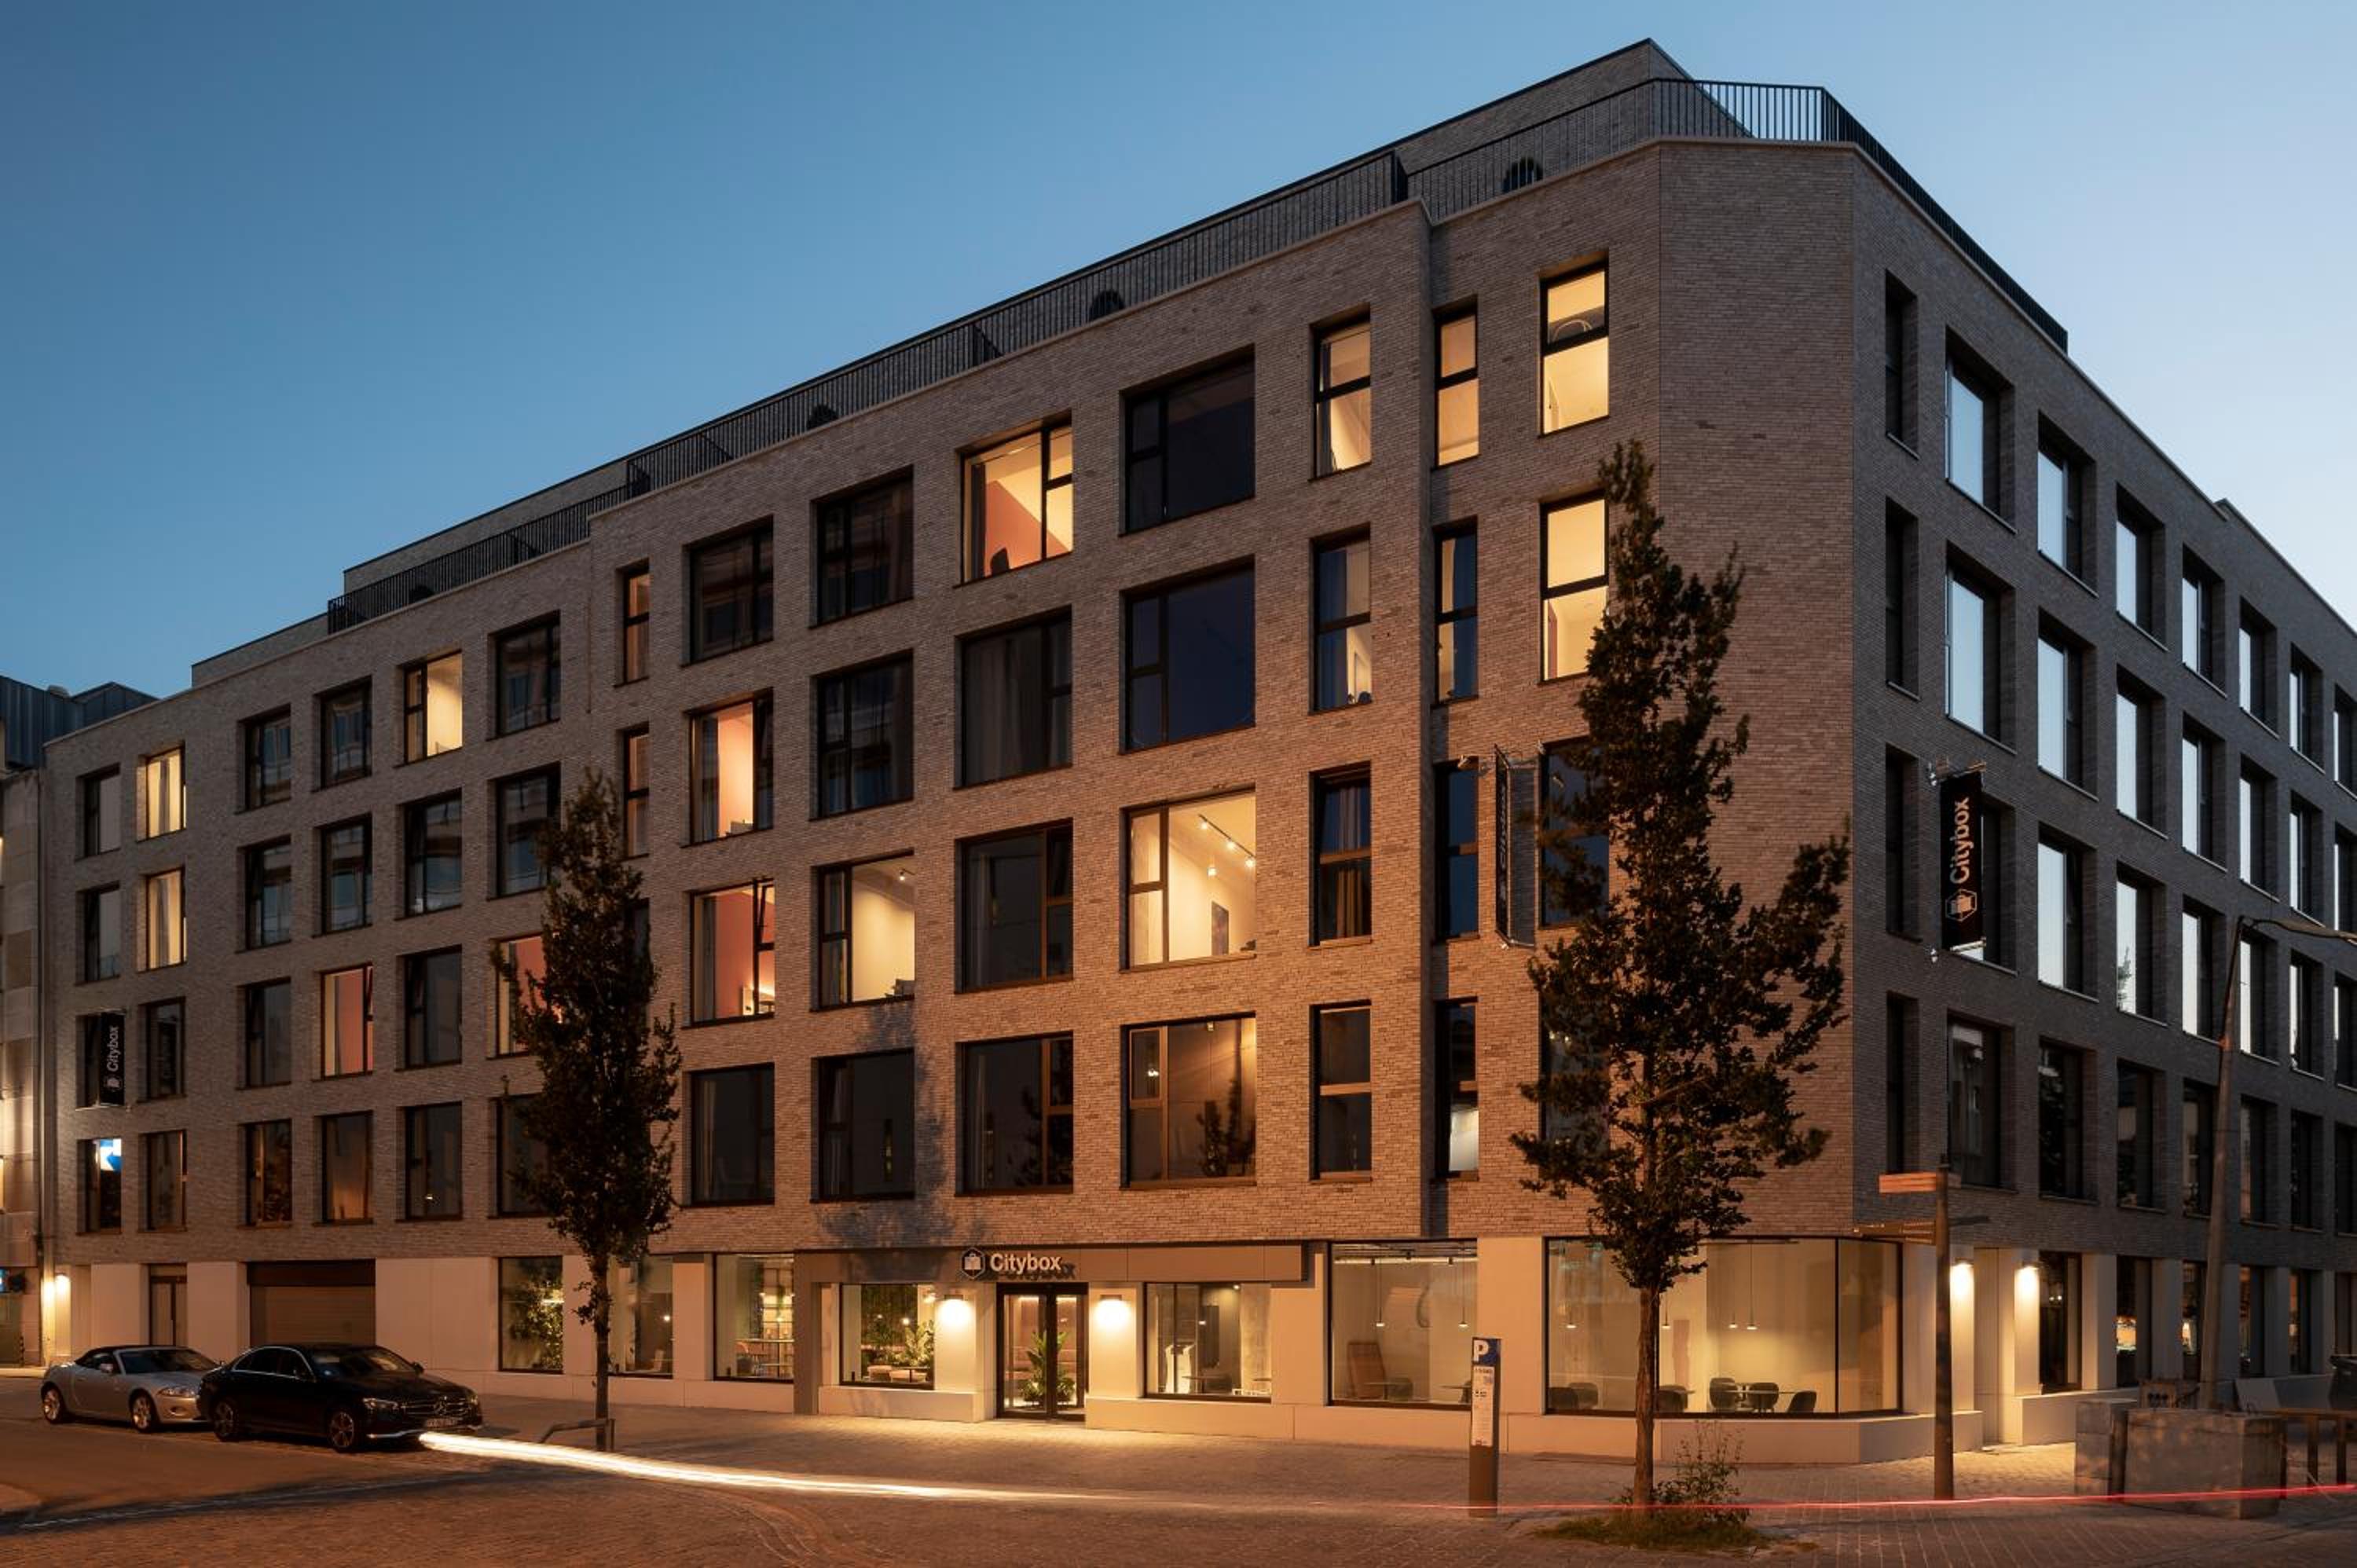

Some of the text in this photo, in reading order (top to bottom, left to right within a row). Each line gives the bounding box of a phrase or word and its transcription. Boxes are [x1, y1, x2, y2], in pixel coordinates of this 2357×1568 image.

[1950, 797, 1975, 885] Citybox
[107, 1025, 122, 1072] Citybox
[990, 1252, 1062, 1274] Citybox
[1473, 1339, 1489, 1361] P
